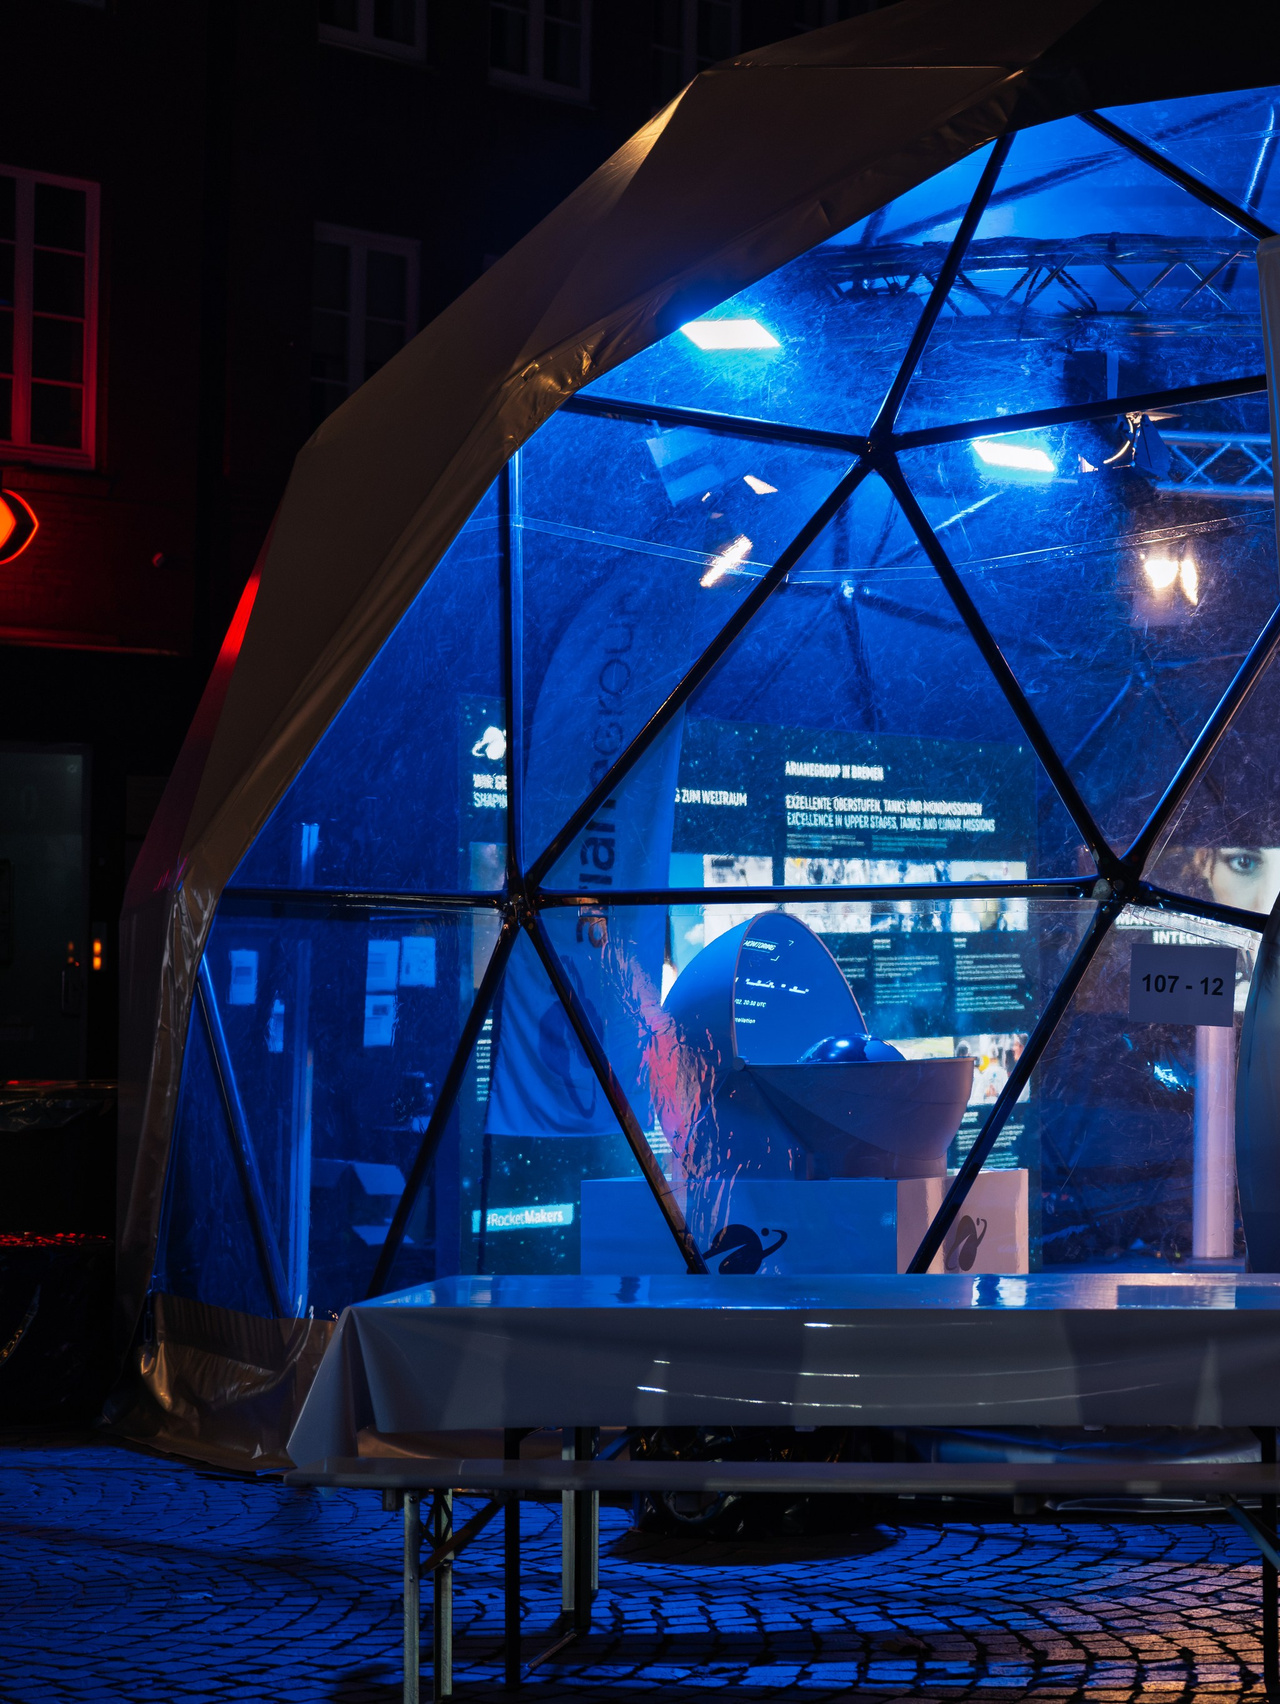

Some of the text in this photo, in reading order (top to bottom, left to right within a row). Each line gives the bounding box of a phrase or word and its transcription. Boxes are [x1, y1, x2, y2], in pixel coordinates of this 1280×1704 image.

[785, 761, 884, 781] ARIANEGROUP IN BREMEN
[681, 789, 700, 803] ZUM
[702, 790, 747, 806] WELTRAUM
[785, 794, 833, 811] EXZELLENTE
[833, 797, 882, 814] OBERSTUFEN,
[883, 799, 905, 813] TANKS
[787, 812, 833, 827] EXCELLENCE
[835, 814, 842, 826] IN
[844, 815, 869, 829] UPPER
[900, 817, 921, 830] TANKS
[963, 819, 995, 832] MISSIONS
[1142, 973, 1179, 993] 107
[1200, 977, 1223, 996] 12
